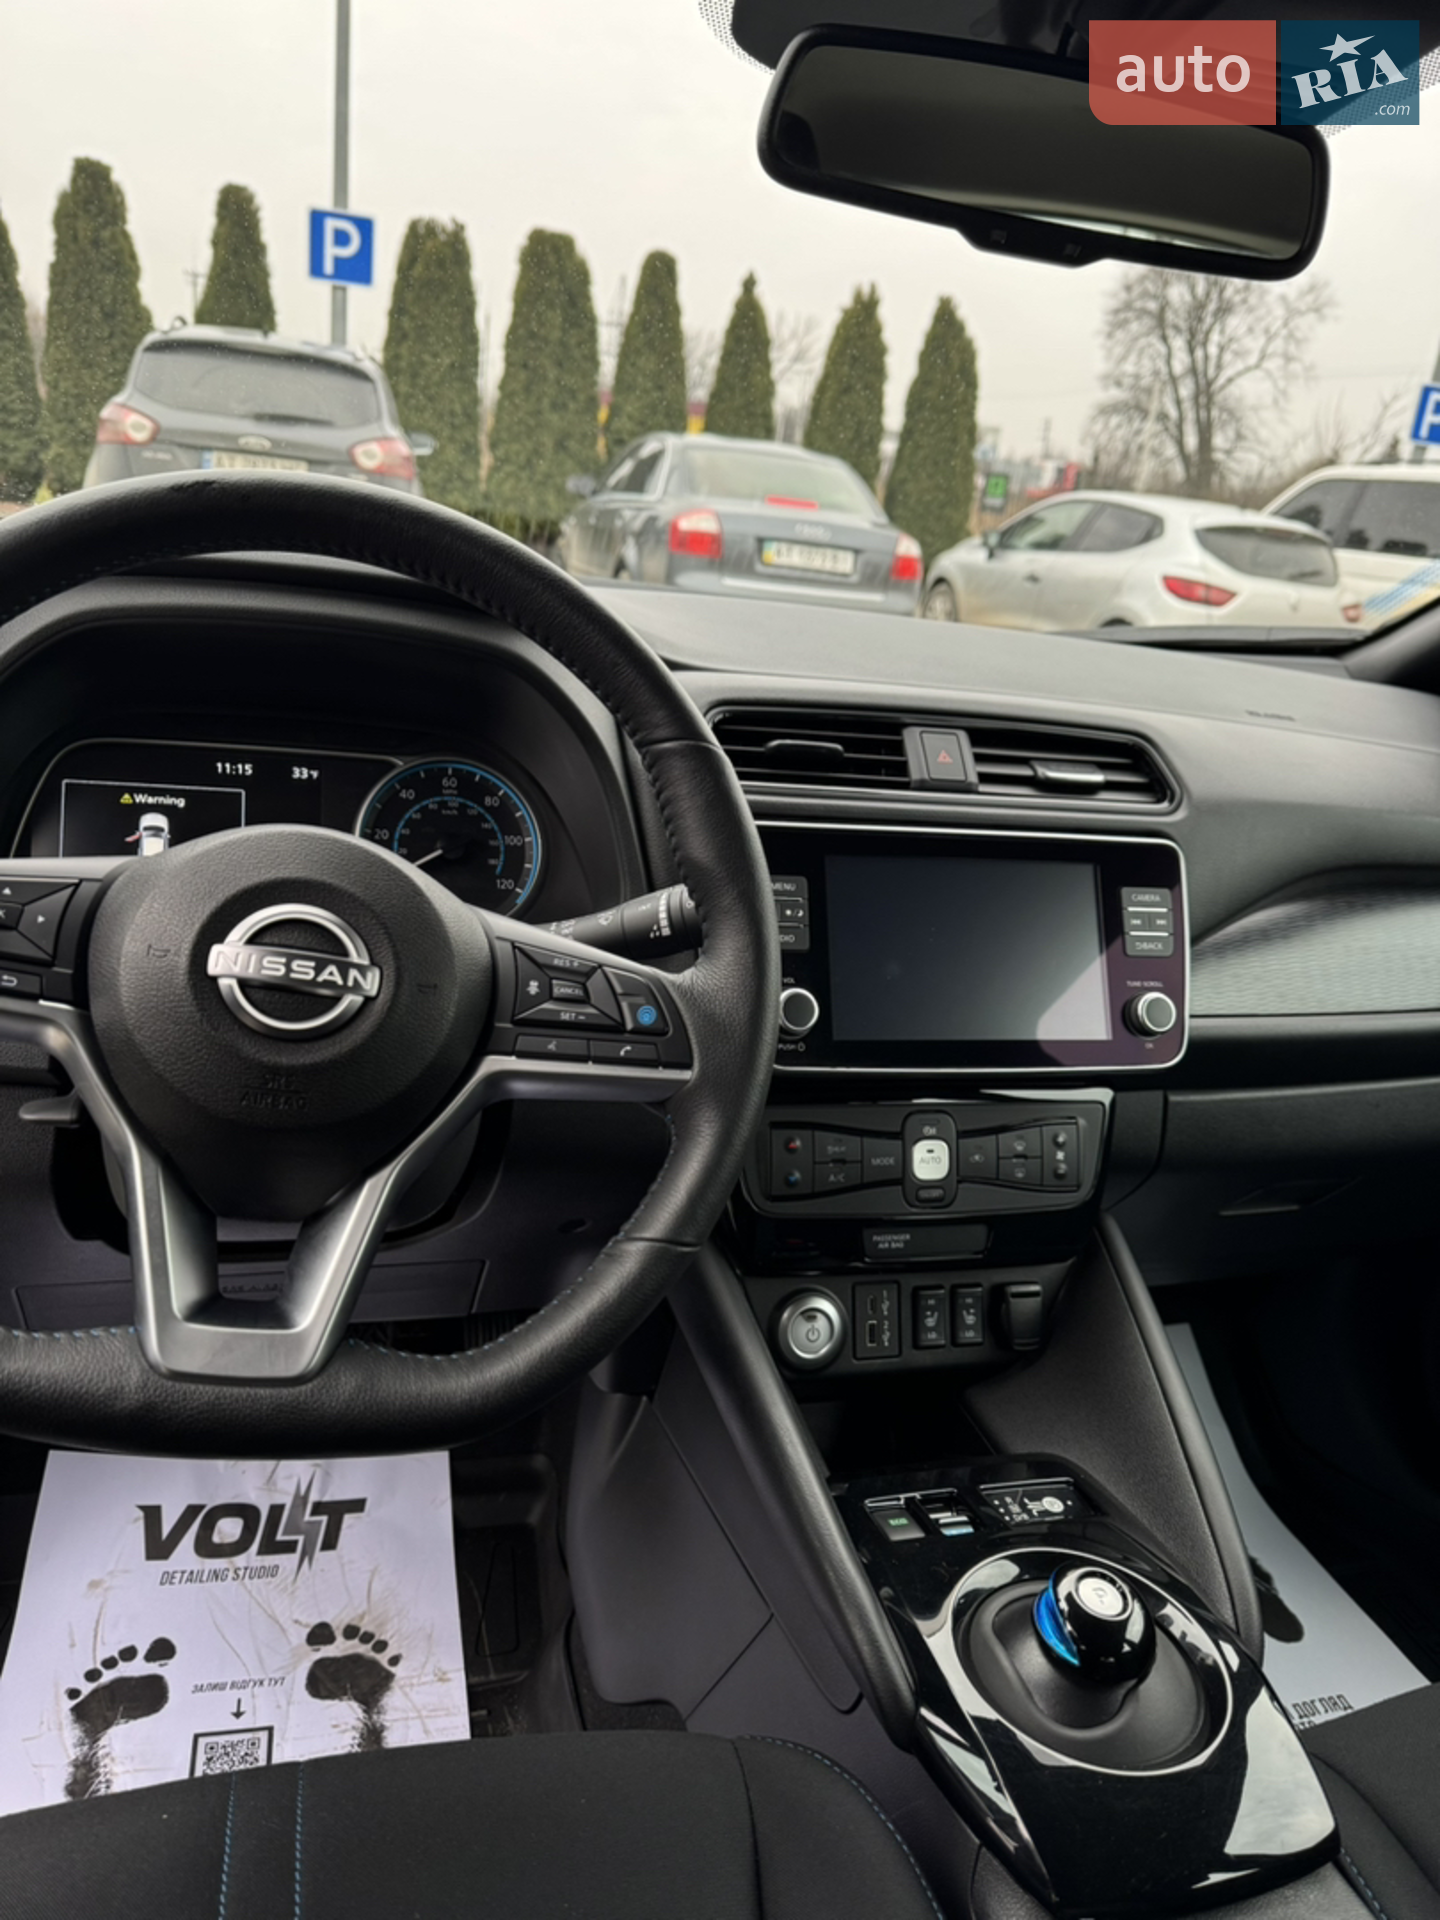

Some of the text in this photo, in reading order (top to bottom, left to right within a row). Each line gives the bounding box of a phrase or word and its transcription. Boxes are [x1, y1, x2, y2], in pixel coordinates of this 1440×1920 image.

[323, 216, 362, 276] P
[216, 762, 253, 775] 11:15
[442, 777, 457, 788] 60
[400, 788, 415, 800] 40
[133, 793, 186, 808] Warning
[484, 796, 500, 807] 80
[374, 829, 389, 840] 20
[504, 835, 523, 846] 100
[496, 879, 514, 890] 120
[1131, 893, 1162, 902] CAMERA
[214, 950, 374, 991] NISSAN
[554, 986, 584, 996] CANCEL
[560, 1012, 576, 1021] SET
[871, 1157, 895, 1166] MODE
[918, 1156, 942, 1165] AUTO
[872, 1233, 911, 1242] PASSENGER
[135, 1497, 368, 1561] VOLT
[159, 1564, 280, 1586] DETAILING STUDIO
[191, 1681, 229, 1694] ЗАЛИШ
[267, 1676, 286, 1688] ТУТ
[1291, 1693, 1354, 1719] ДОГЛЯД
